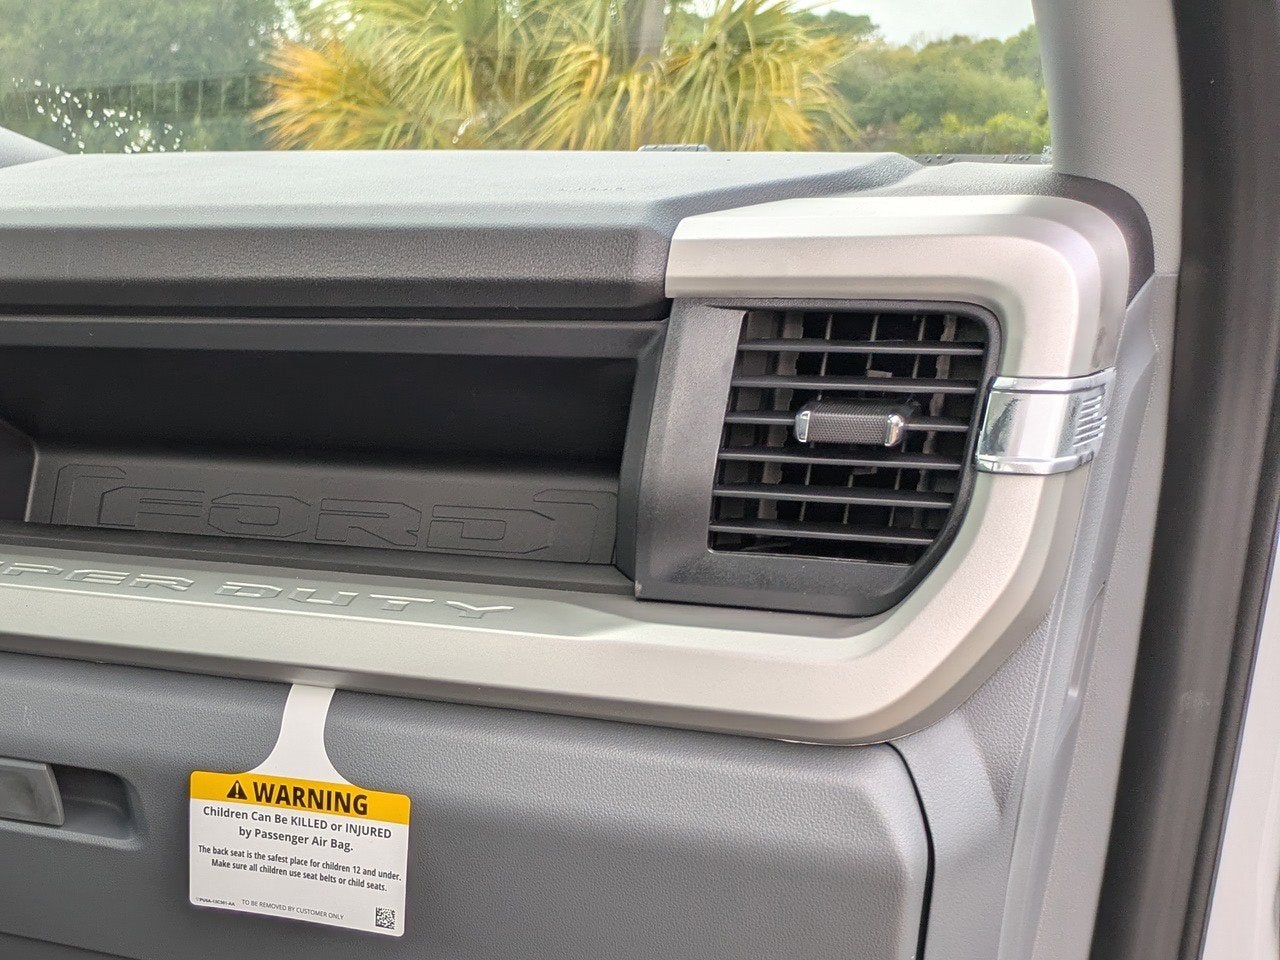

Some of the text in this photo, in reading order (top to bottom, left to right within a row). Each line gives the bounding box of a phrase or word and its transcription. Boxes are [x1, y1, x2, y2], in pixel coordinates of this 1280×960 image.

[213, 580, 516, 620] DUTY
[253, 782, 368, 815] WARNING
[203, 807, 392, 839] Children Can Be KILLED or INJURED
[239, 826, 353, 852] by Passenger Air Bag.
[198, 845, 402, 881] The back seat is the safest place for children 12 and under.
[211, 859, 387, 892] Make sure all children use seat belts or child seats.
[259, 901, 286, 912] REMOVED
[288, 904, 295, 912] BY
[296, 906, 327, 918] CUSTOMER
[328, 912, 344, 920] ONLY
